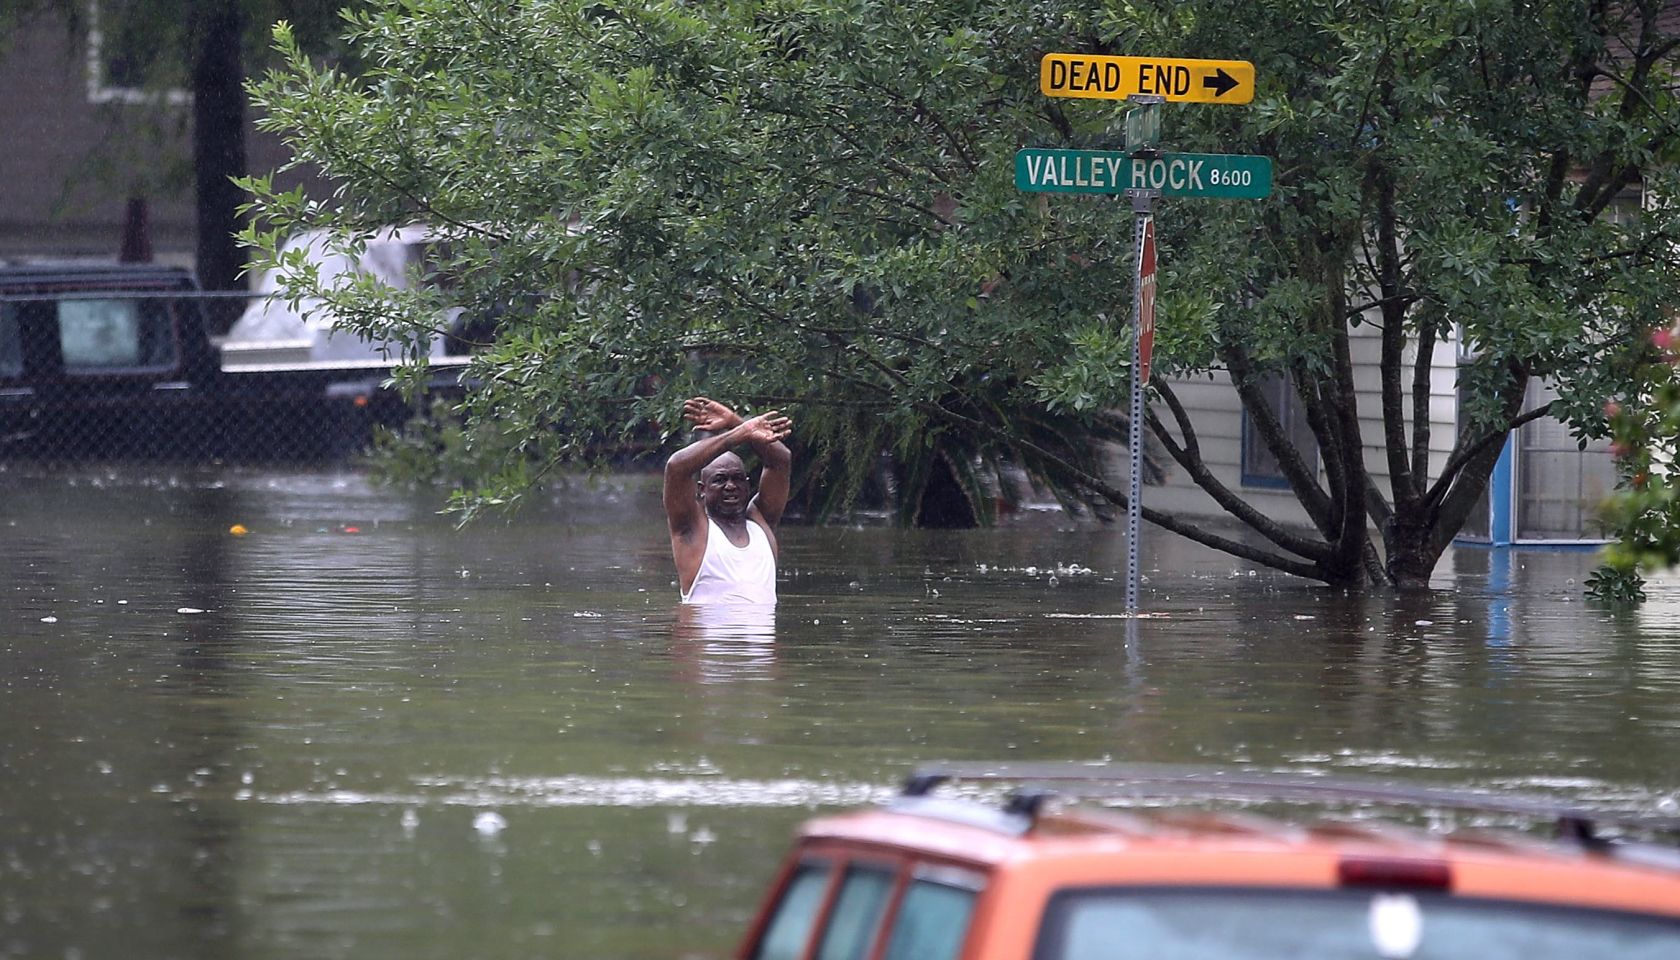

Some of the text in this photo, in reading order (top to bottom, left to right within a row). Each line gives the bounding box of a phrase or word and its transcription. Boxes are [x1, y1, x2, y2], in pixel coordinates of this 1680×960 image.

[1050, 60, 1190, 96] DEAD END
[1026, 155, 1251, 190] VALLEY ROCK 8600
